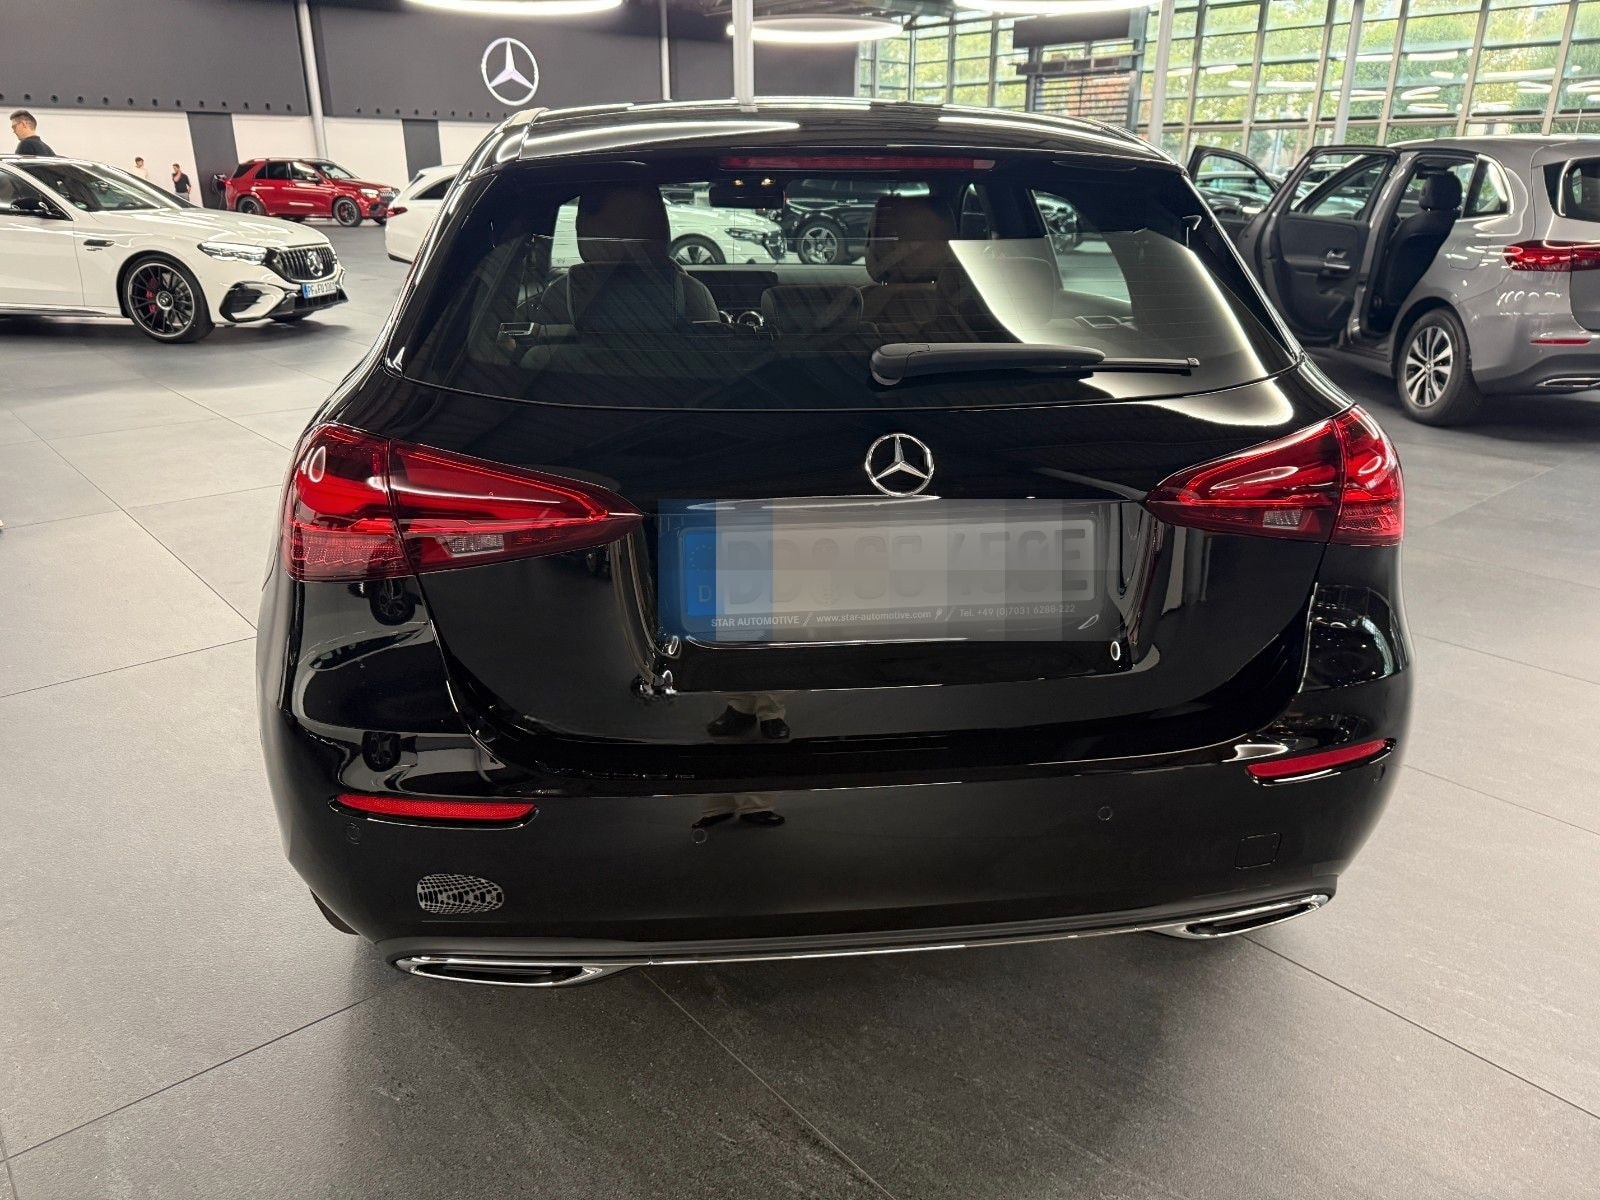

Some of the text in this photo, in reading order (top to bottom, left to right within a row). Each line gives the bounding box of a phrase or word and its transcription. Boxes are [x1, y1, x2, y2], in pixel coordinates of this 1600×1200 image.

[711, 618, 735, 627] STAR
[737, 615, 800, 626] AUTOMOTIVE
[816, 609, 932, 623] www.star-automotive.com
[960, 608, 975, 617] Tel.
[977, 607, 994, 617] +49
[996, 606, 1030, 617] (0)7031
